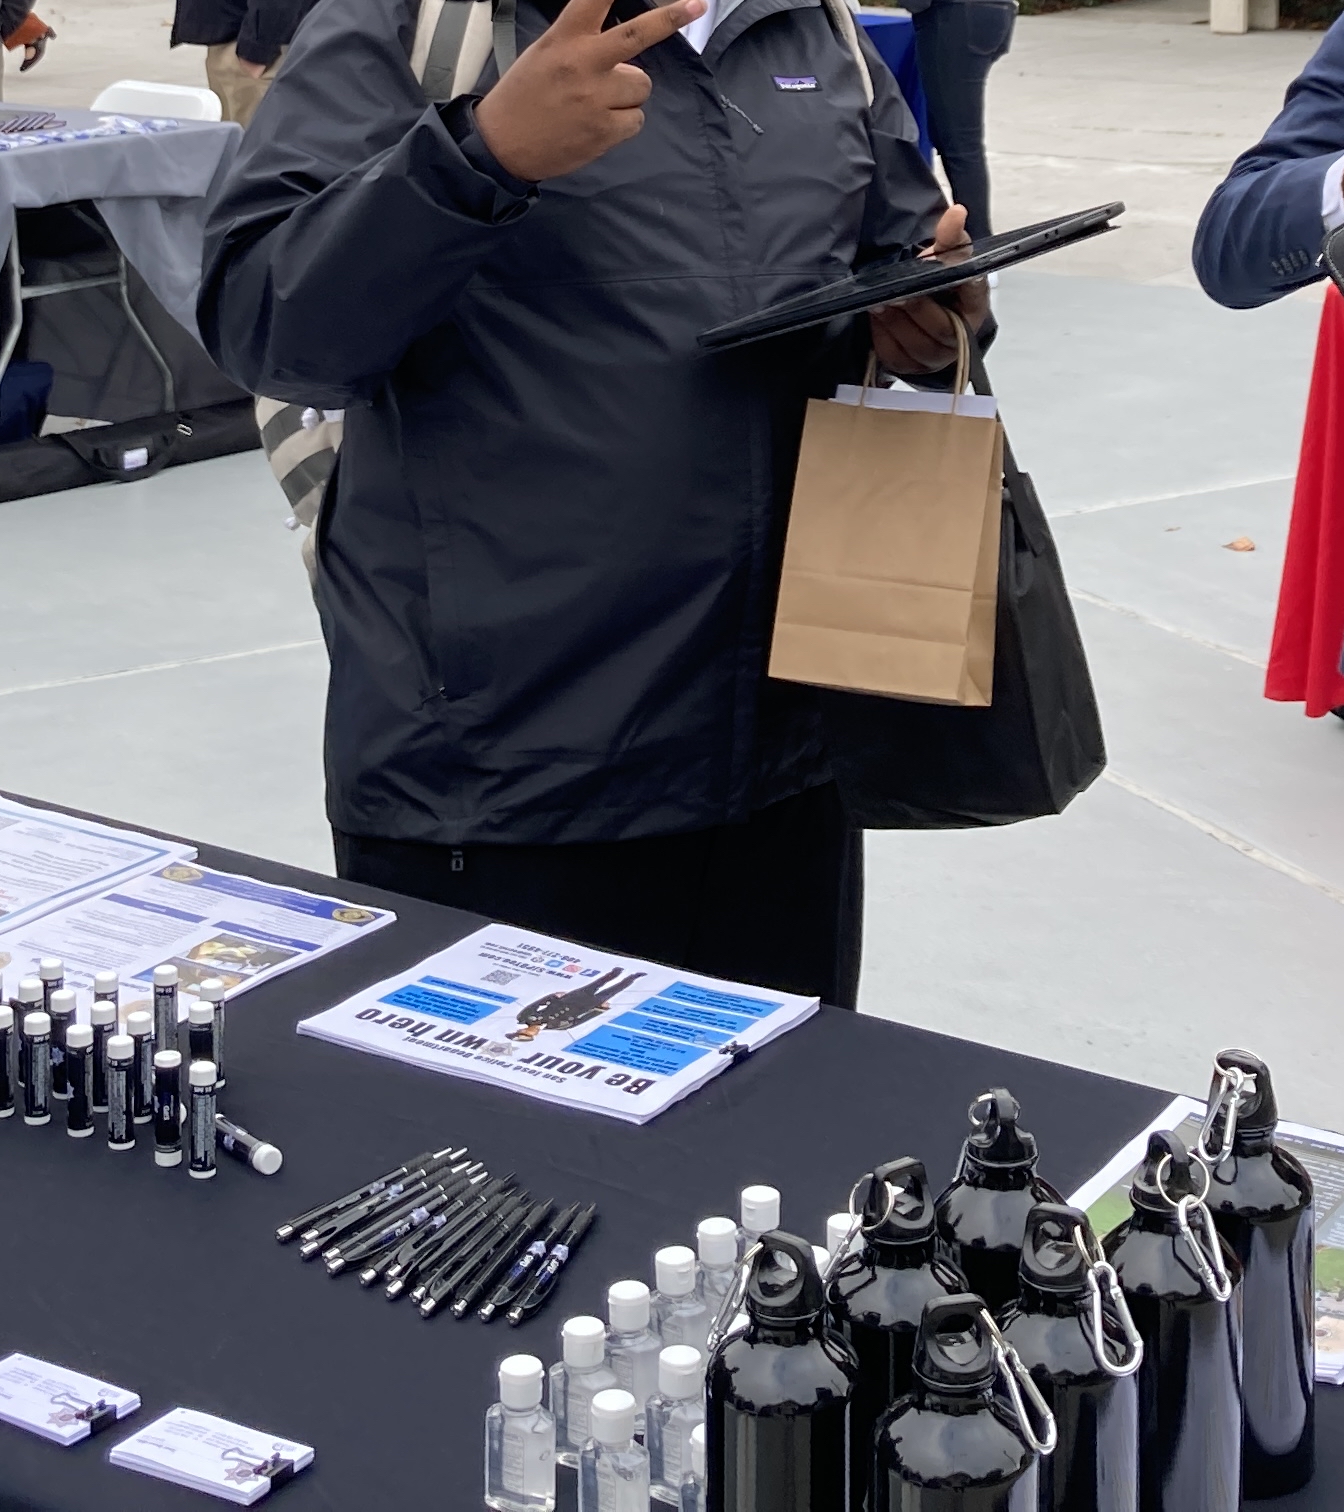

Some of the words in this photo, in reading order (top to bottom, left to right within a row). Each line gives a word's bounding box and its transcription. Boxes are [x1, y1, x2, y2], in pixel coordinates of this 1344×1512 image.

[355, 1008, 437, 1038] hero
[401, 1036, 474, 1059] Department
[434, 1029, 489, 1050] wn
[473, 1055, 514, 1069] Police
[517, 1052, 607, 1080] your
[542, 1073, 567, 1084] San
[604, 1073, 657, 1096] Be
